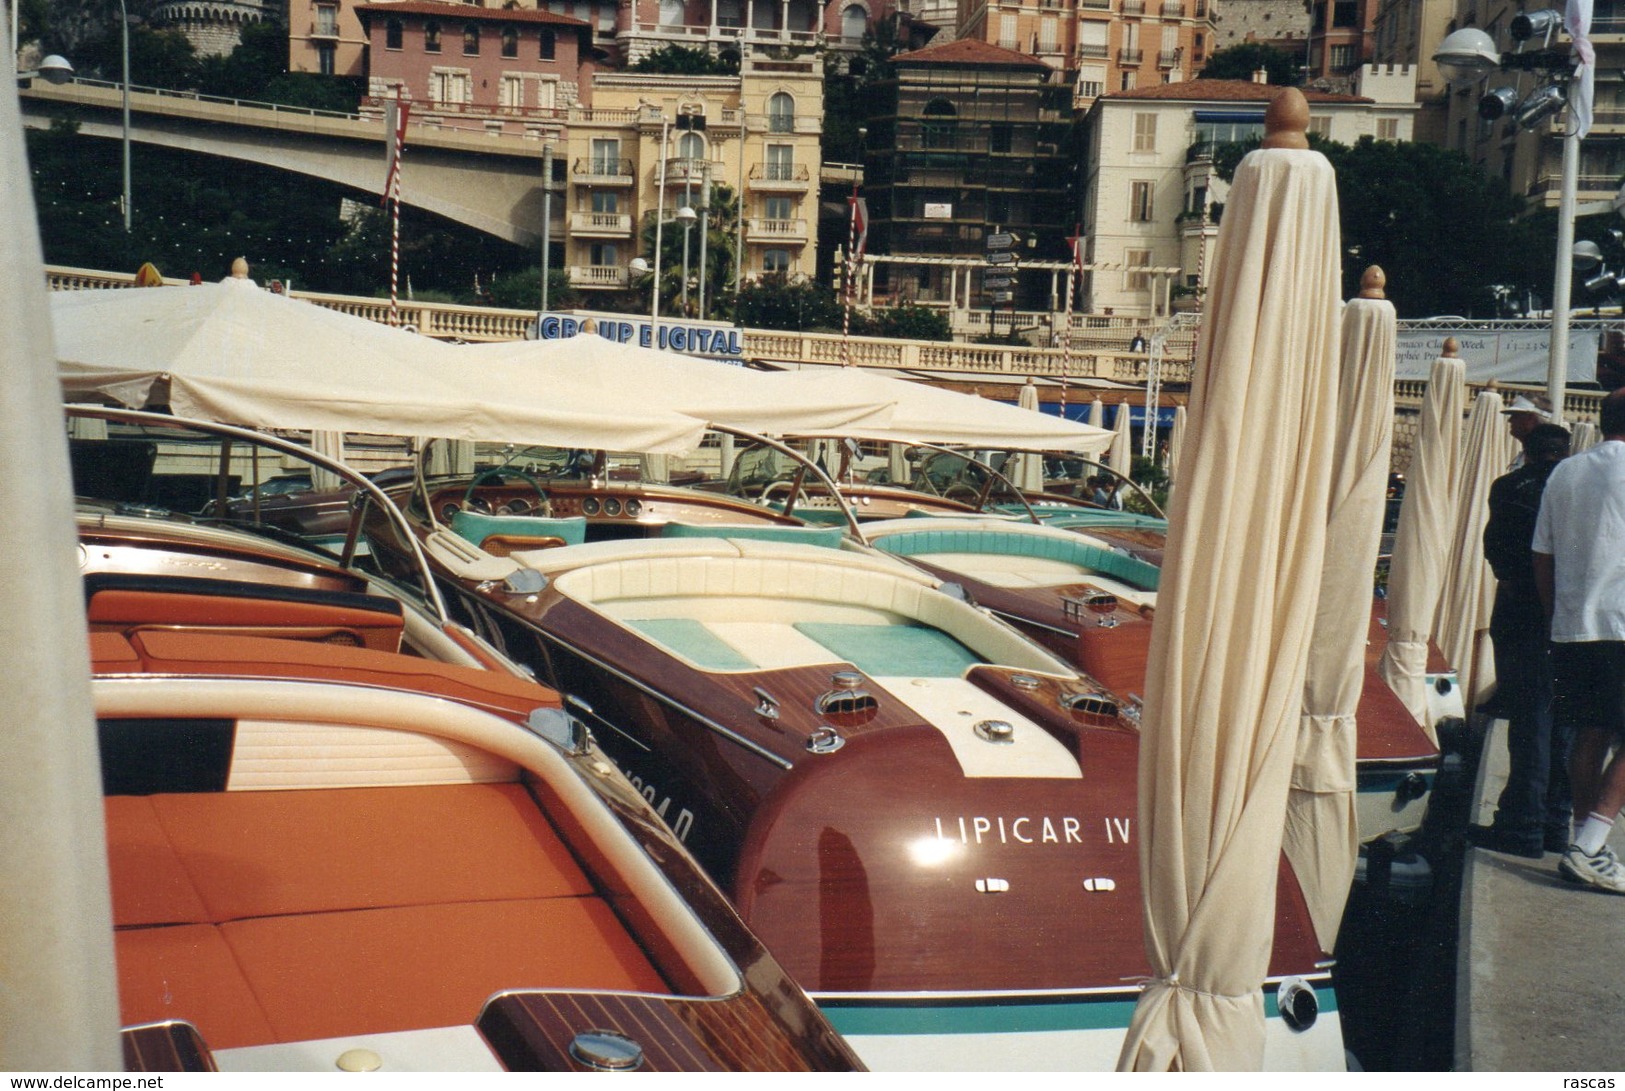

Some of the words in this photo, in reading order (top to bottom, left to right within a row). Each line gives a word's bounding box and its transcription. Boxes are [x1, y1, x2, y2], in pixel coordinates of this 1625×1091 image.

[639, 324, 742, 354] DIGITAL
[1396, 340, 1423, 350] onaco
[1461, 340, 1485, 350] Week
[935, 817, 1082, 844] LIPICAR
[1105, 818, 1130, 844] IV
